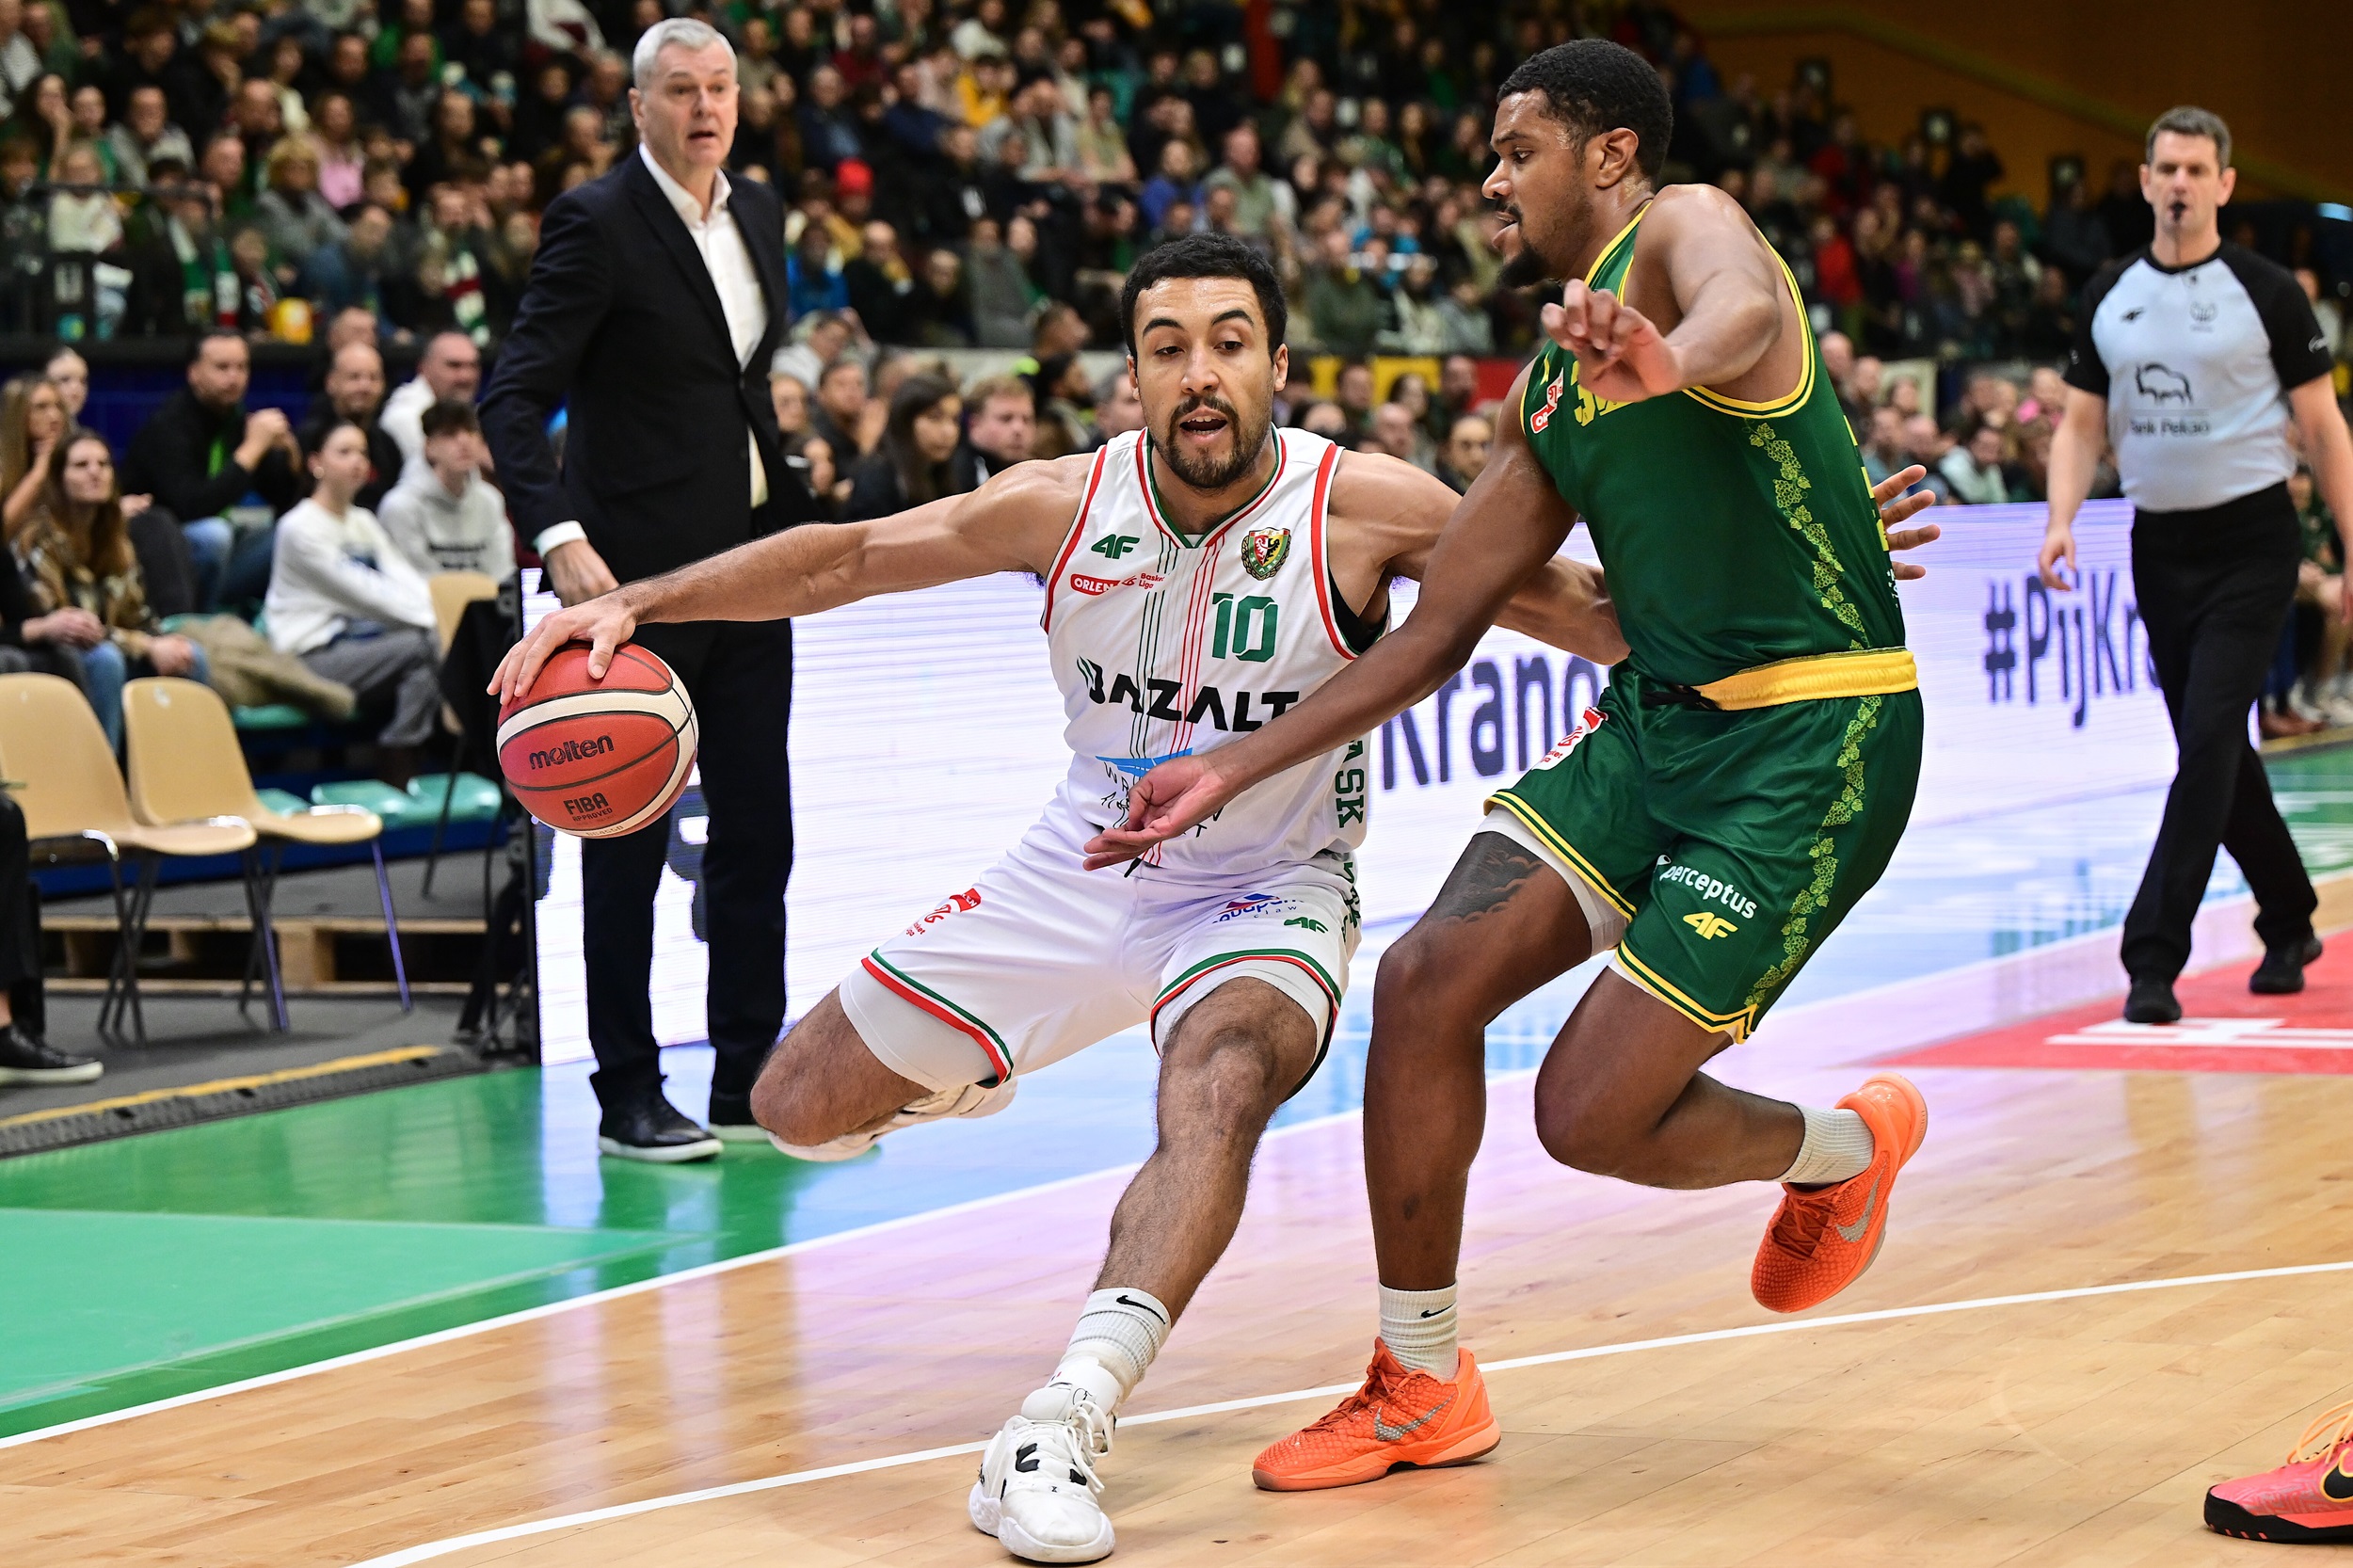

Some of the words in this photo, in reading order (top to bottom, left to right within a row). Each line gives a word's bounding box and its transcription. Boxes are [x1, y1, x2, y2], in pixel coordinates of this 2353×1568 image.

[1091, 534, 1140, 559] 4F
[1212, 592, 1278, 663] 10
[529, 735, 615, 770] molten
[563, 792, 609, 815] FIBA
[572, 808, 614, 822] APPROVED
[1659, 863, 1758, 920] perceptus
[1682, 911, 1738, 940] 4F
